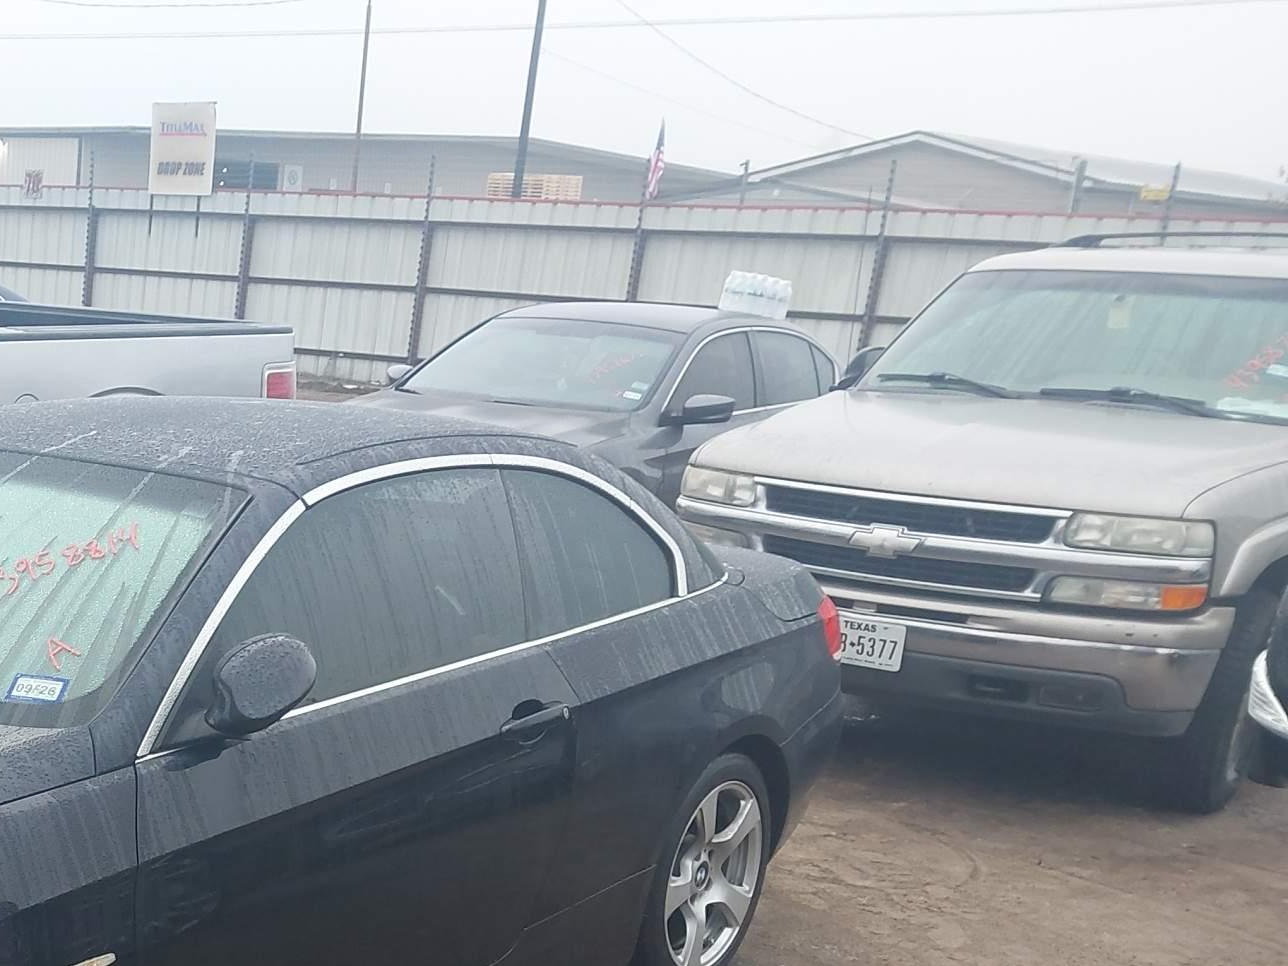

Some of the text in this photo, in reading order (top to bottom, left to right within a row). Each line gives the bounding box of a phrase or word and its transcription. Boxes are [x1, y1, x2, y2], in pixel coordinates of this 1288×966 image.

[157, 161, 206, 176] DROP ZONE
[844, 620, 878, 633] TEXAS
[47, 637, 82, 672] A
